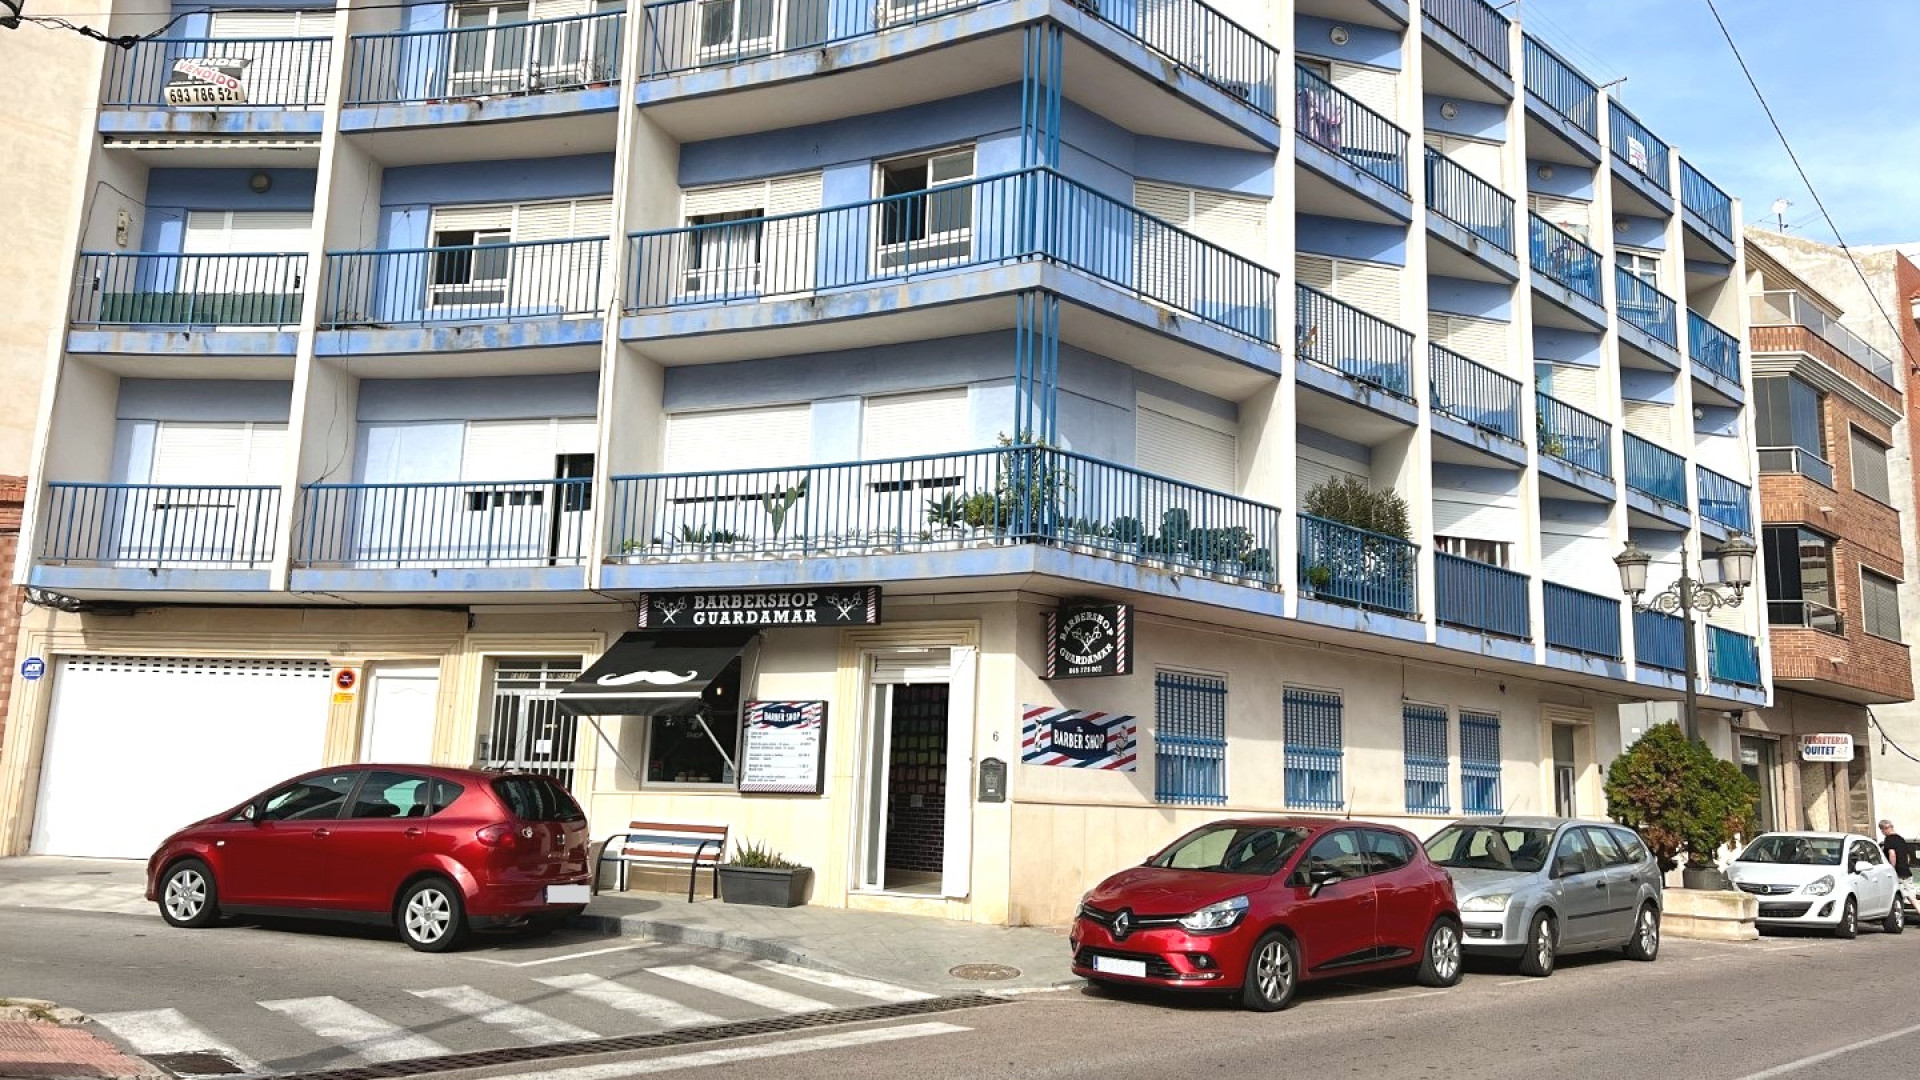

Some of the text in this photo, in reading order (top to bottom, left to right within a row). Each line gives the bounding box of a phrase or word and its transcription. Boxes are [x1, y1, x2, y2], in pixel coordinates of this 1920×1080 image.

[179, 62, 238, 89] VENDIDO
[170, 88, 191, 103] 693
[193, 88, 215, 102] 786
[693, 592, 818, 609] BARBERSHOP
[692, 609, 817, 625] GUARDAMAR
[1060, 611, 1114, 641] BARBERSHOP
[1060, 643, 1114, 665] GUARDAMAR
[992, 730, 1000, 742] 6
[1054, 728, 1105, 749] BARBER SHOP
[1805, 746, 1836, 756] QUITET
